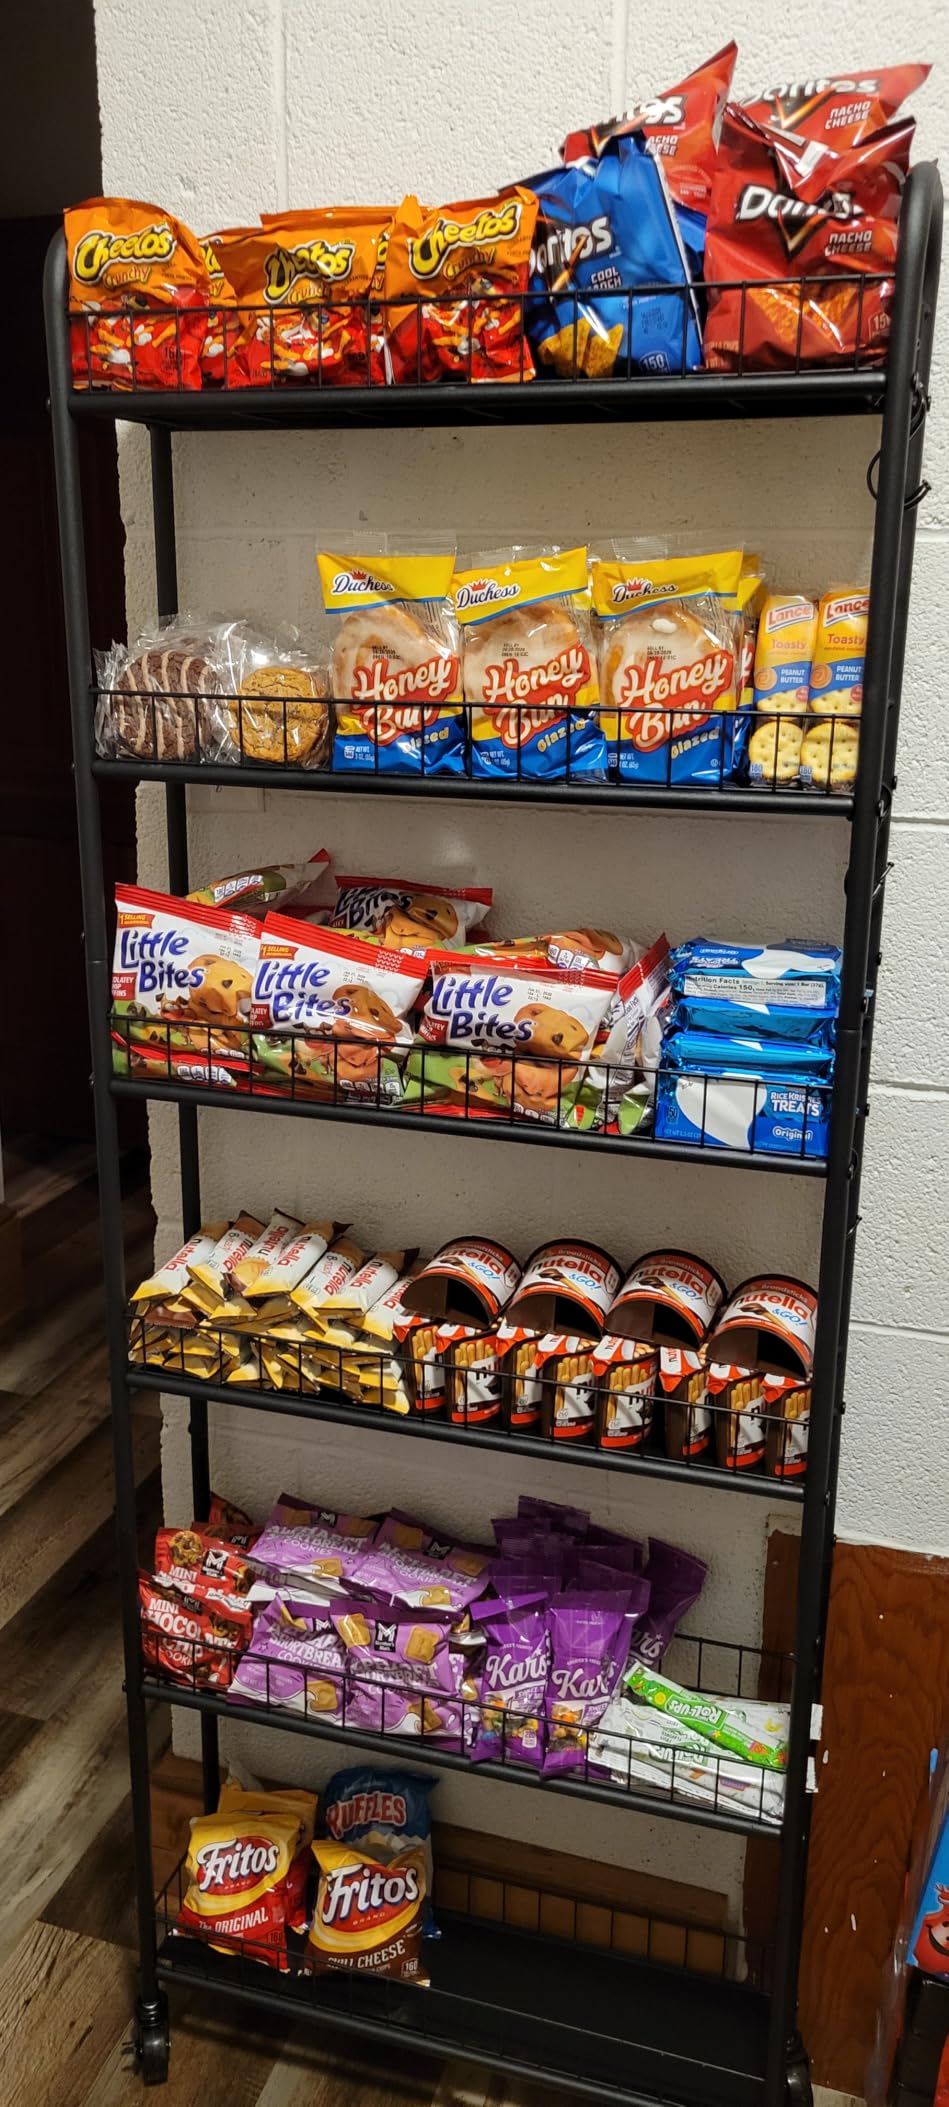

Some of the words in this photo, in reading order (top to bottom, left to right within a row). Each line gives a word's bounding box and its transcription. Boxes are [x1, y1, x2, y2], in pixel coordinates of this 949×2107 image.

[825, 111, 870, 130] CHEESE
[830, 100, 871, 119] NACHO
[649, 135, 679, 145] ACHO
[411, 203, 519, 275] Cheetos
[825, 242, 872, 256] CHEESE
[829, 230, 872, 244] NACHO
[75, 226, 174, 282] Cheetos
[443, 247, 496, 279] Crunchy
[104, 265, 150, 288] Crunchy
[588, 276, 622, 290] ANCH
[591, 266, 619, 284] COOL
[643, 354, 664, 370] 150
[332, 575, 393, 593] Duchess
[457, 582, 518, 608] Duchess
[614, 582, 677, 603] Duchess
[768, 607, 812, 626] Lance
[826, 598, 869, 621] Lance
[771, 639, 807, 650] Toasty
[828, 633, 864, 646] Toasty
[354, 657, 452, 702] Honey
[486, 647, 583, 703] Honey
[621, 653, 726, 709] Honey
[780, 676, 804, 684] BUTTER
[781, 669, 804, 677] PEANUT
[836, 673, 860, 682] BUTTER
[837, 666, 862, 674] PEANUT
[495, 692, 569, 744] Bun
[631, 699, 705, 748] Bun
[671, 727, 719, 759] Glazed
[121, 929, 189, 969] Little
[138, 960, 205, 993] Bites
[255, 961, 330, 1000] Little
[719, 977, 740, 985] Facts
[273, 991, 351, 1022] Bites
[433, 975, 514, 1016] Little
[451, 1011, 533, 1041] Bites
[771, 1092, 787, 1100] RICE
[772, 1100, 821, 1117] TREATS
[258, 1225, 289, 1256] nutella
[277, 1234, 312, 1267] nutella
[165, 1238, 202, 1271] nutella
[224, 1238, 253, 1272] nutella
[440, 1248, 502, 1275] nutella
[324, 1261, 352, 1296] nutella
[350, 1261, 383, 1288] nutella
[468, 1262, 501, 1281] &GO!
[531, 1258, 603, 1284] nutella
[568, 1273, 602, 1290] &GO!
[632, 1265, 704, 1295] nutella
[668, 1282, 703, 1301] &GO!
[733, 1292, 808, 1320] nutella
[772, 1307, 808, 1327] &GO!
[283, 1538, 333, 1556] COOKIES
[169, 1565, 197, 1582] MINI
[149, 1598, 179, 1615] MINI
[269, 1633, 345, 1669] SHORTBREA
[327, 1792, 406, 1839] RUFFLES
[197, 1838, 280, 1892] Fritos
[322, 1864, 418, 1925] Fritos
[214, 1907, 269, 1934] ORIGINAL
[357, 1939, 406, 1969] CHEESE
[405, 1960, 418, 1971] 160
